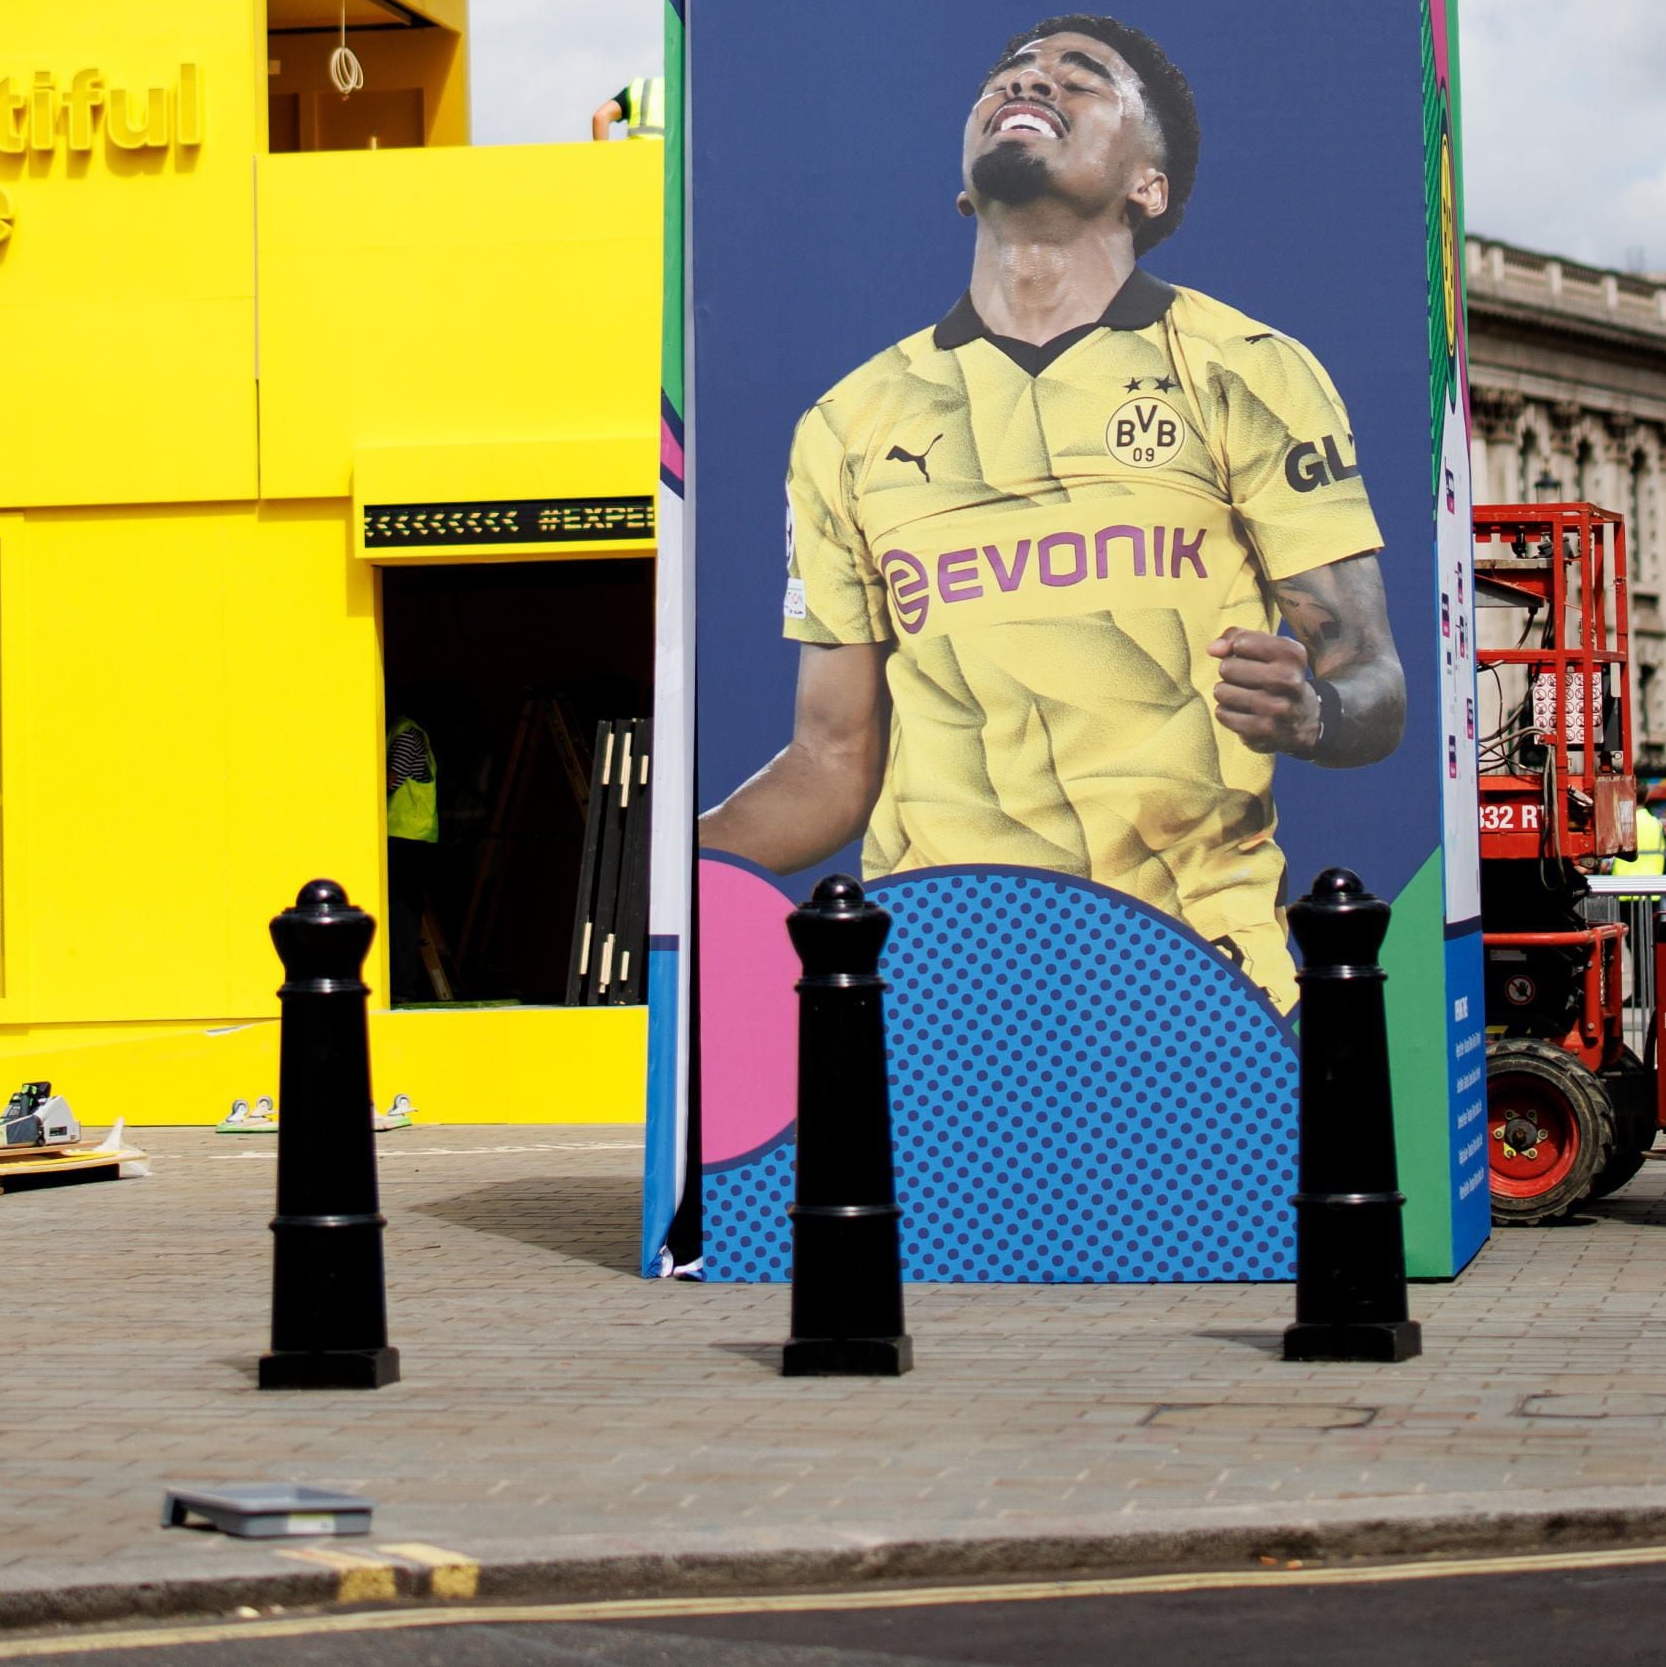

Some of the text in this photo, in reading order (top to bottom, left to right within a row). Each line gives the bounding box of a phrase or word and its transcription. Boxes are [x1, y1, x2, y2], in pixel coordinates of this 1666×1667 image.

[1116, 404, 1177, 448] BVB
[1132, 447, 1155, 462] 09
[1284, 433, 1360, 493] GL
[936, 524, 1209, 605] EVONIK
